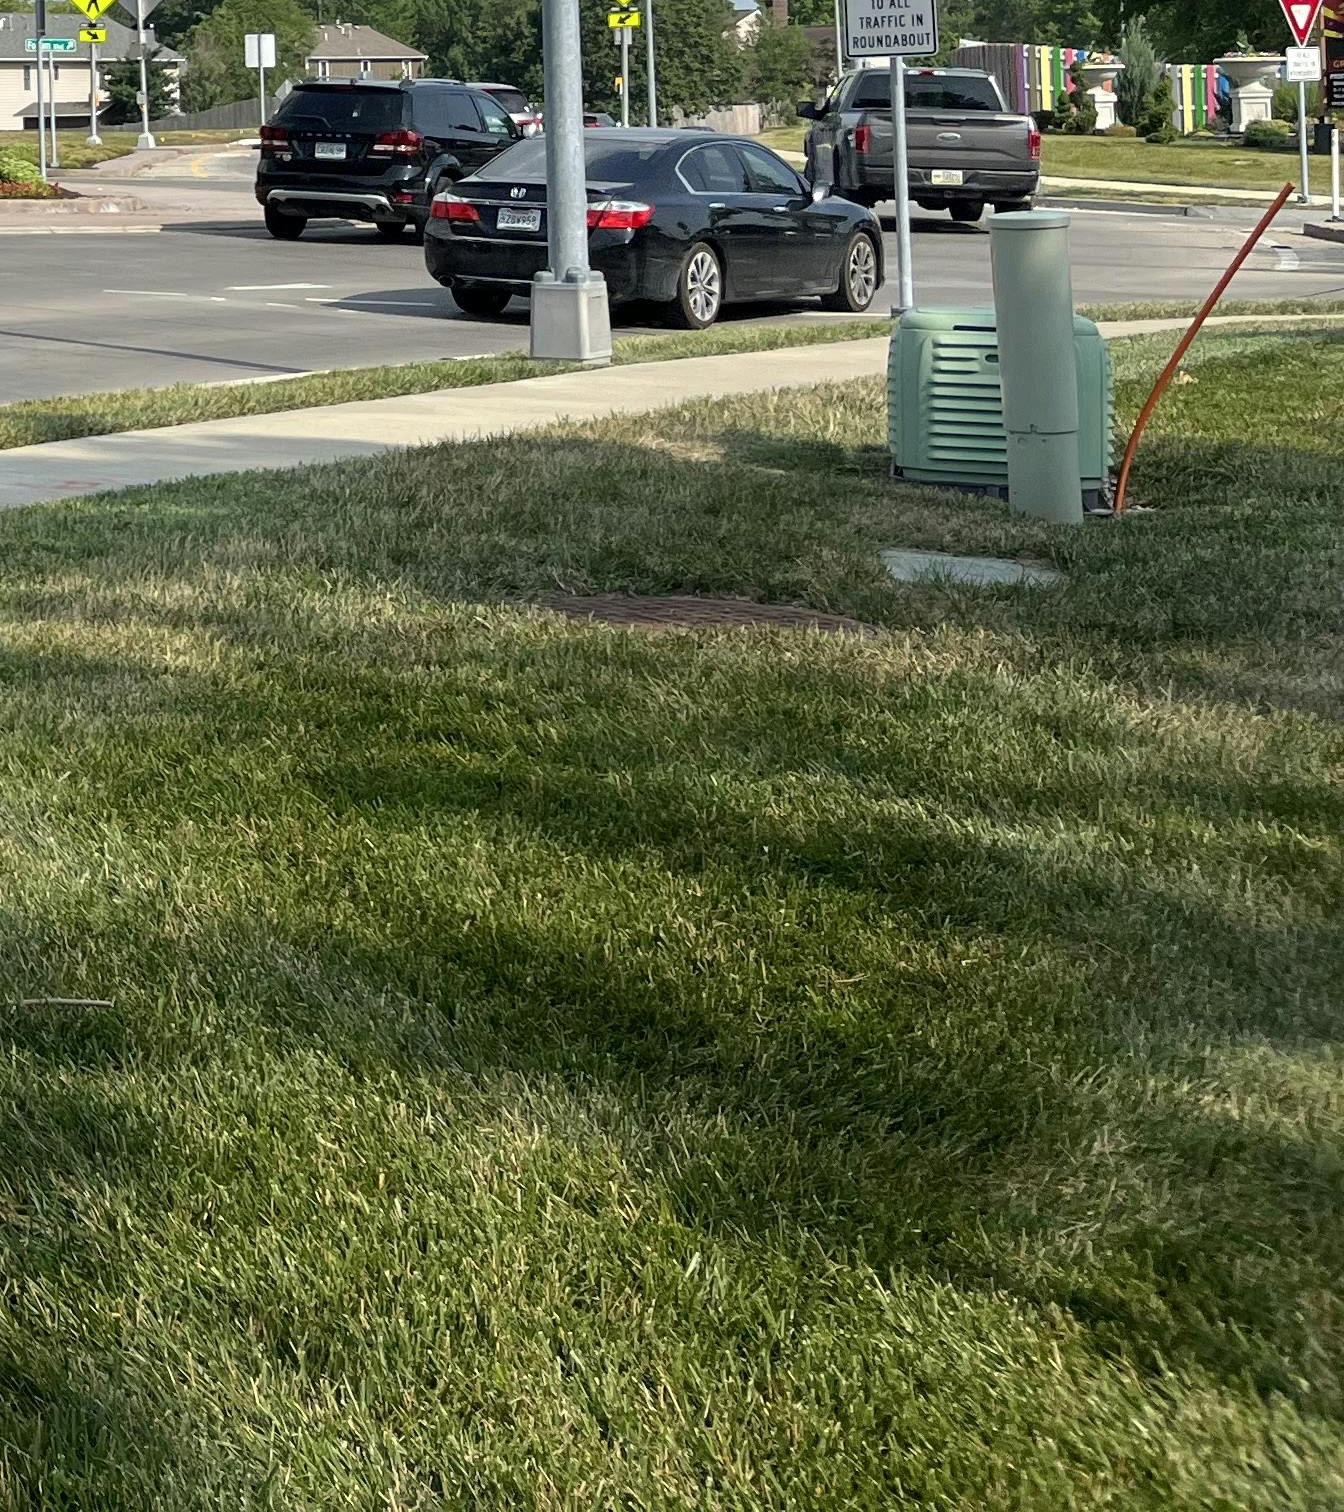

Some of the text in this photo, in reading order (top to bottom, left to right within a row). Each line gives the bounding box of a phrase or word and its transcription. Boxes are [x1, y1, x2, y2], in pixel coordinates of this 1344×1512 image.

[859, 13, 924, 29] TRAFFIC IN
[852, 32, 931, 49] ROUNDABOUT
